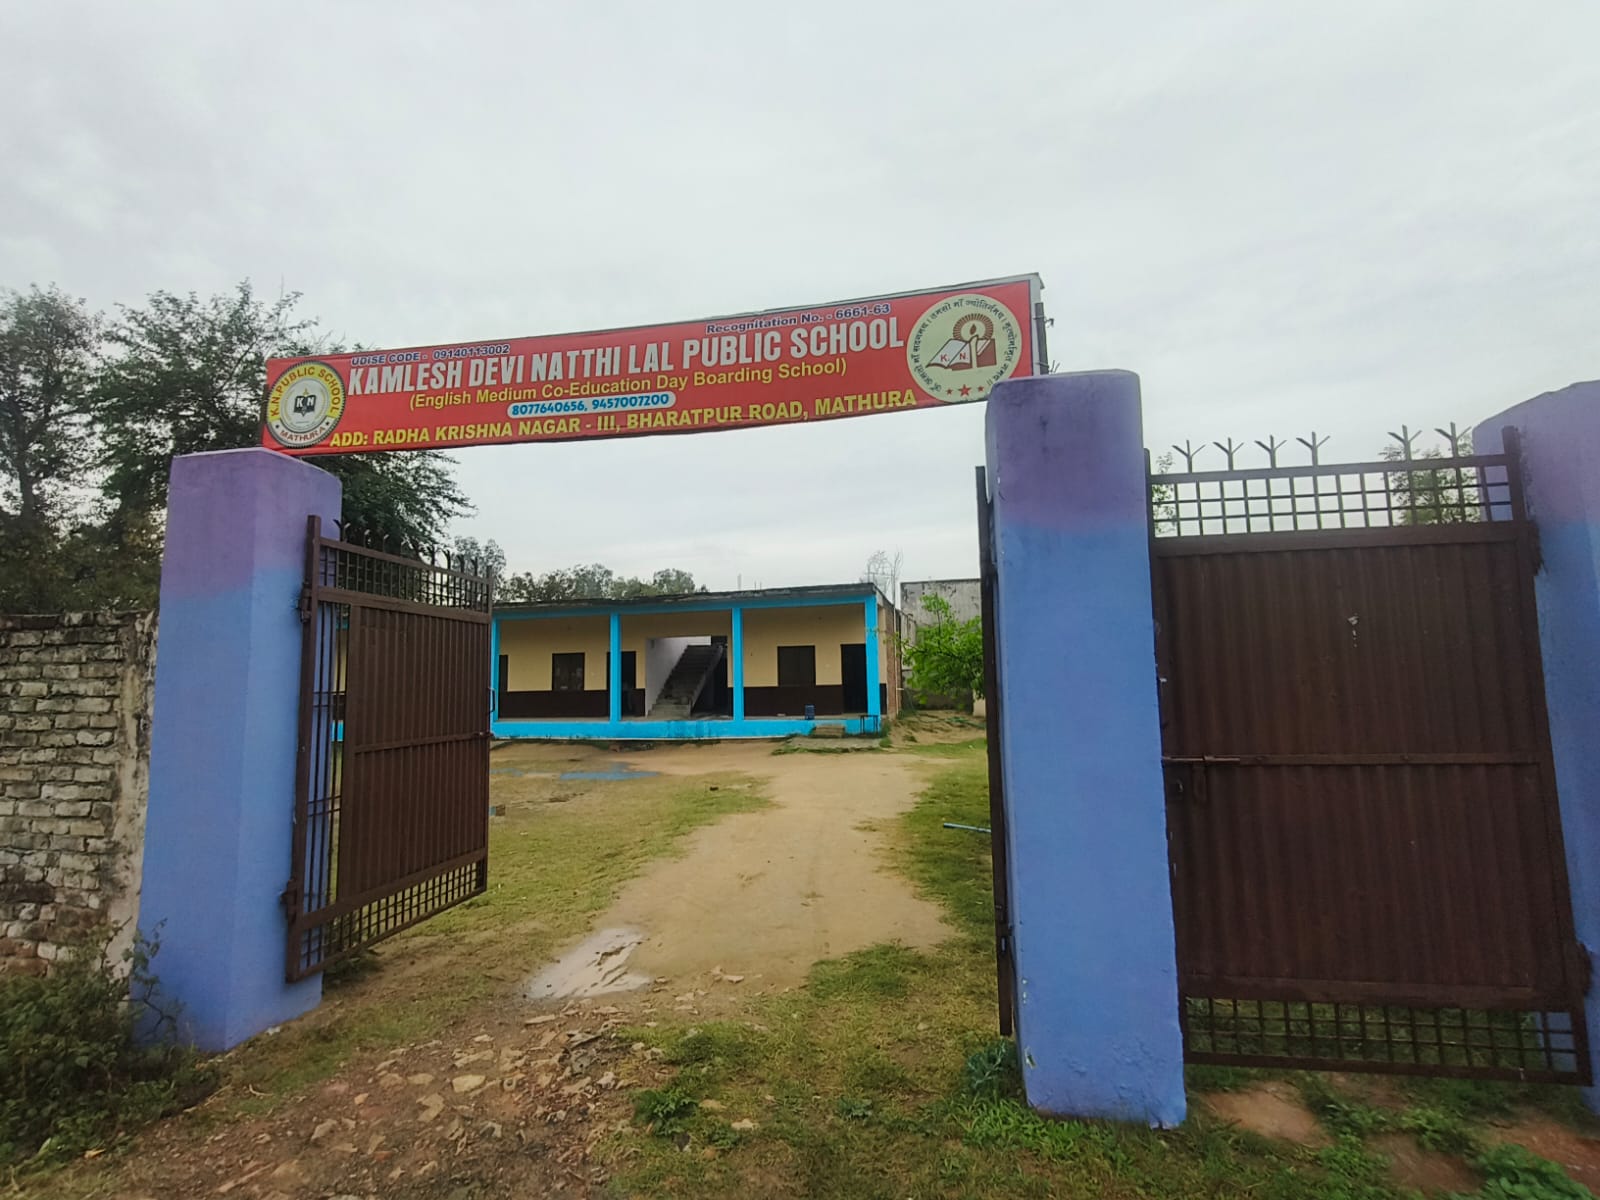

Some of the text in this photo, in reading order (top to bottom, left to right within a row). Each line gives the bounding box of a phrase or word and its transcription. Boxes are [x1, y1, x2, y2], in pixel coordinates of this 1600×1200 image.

[706, 317, 797, 334] Recognitation
[835, 303, 891, 320] 6661-63
[348, 316, 904, 396] KAMLESH DEVI NATTHI LAL PUBLIC SCHOOL
[389, 352, 420, 363] CODE
[433, 344, 510, 359] 09140113002
[318, 369, 341, 414] SCHOOL
[409, 357, 847, 411] (English Medium Co-Education Day Boarding School)
[592, 393, 669, 410] 9457007200
[280, 426, 327, 442] MATHURA
[329, 431, 368, 448] ADD:
[373, 427, 430, 445] RADHA
[435, 422, 512, 441] KRISHNA
[518, 417, 581, 436] NAGAR
[627, 405, 743, 430] BHARATPUR
[749, 401, 809, 420] ROAD,
[815, 389, 917, 416] MATHURA
